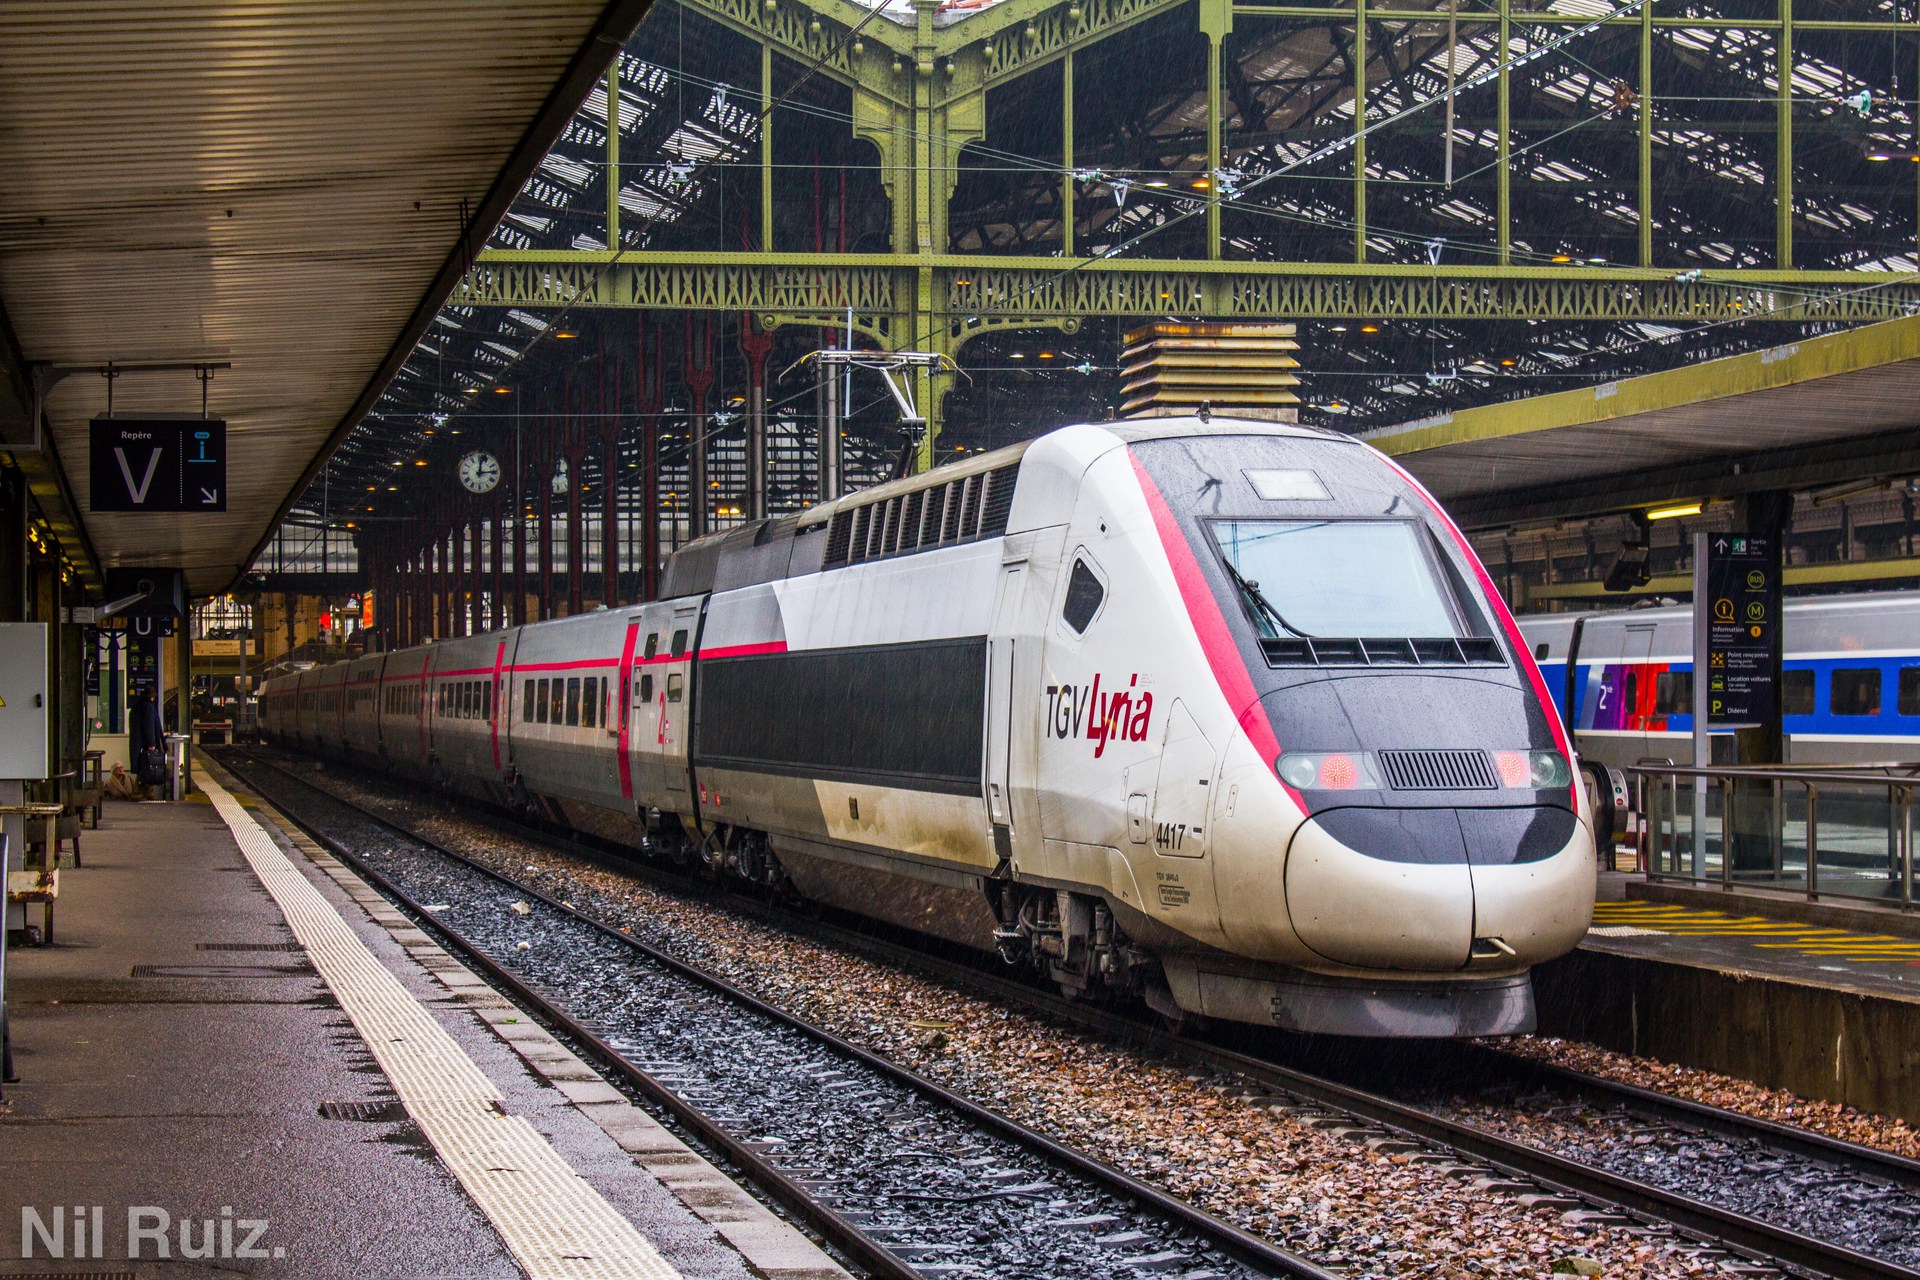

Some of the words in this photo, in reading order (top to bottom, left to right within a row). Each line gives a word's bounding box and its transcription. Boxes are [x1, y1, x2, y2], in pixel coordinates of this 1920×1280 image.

[121, 431, 152, 440] Repère
[114, 447, 163, 503] V
[1749, 575, 1763, 584] BUS
[1047, 684, 1089, 740] TGV
[1086, 673, 1153, 759] Lyria
[1712, 700, 1722, 713] P
[1156, 822, 1187, 850] 4417
